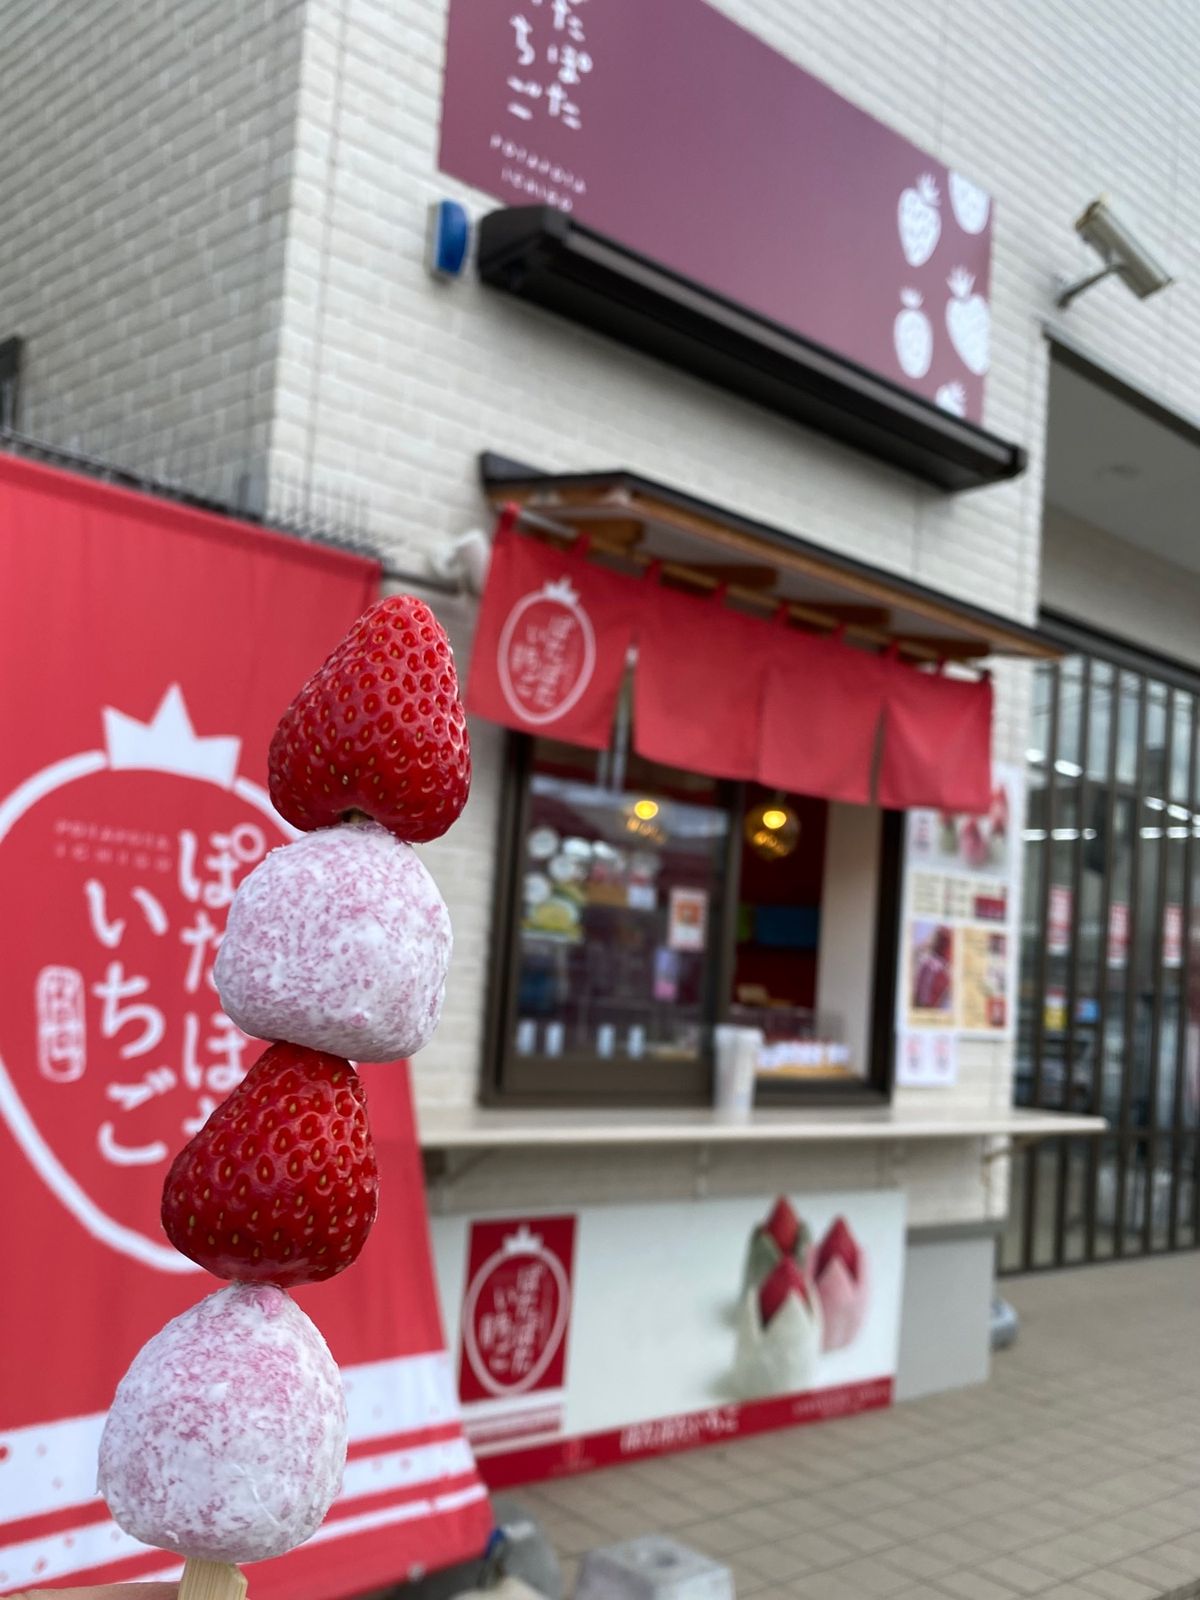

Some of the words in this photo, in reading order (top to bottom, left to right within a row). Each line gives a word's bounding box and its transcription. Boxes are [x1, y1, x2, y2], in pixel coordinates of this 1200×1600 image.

[546, 0, 593, 130] たぽた
[85, 878, 177, 1165] いちご
